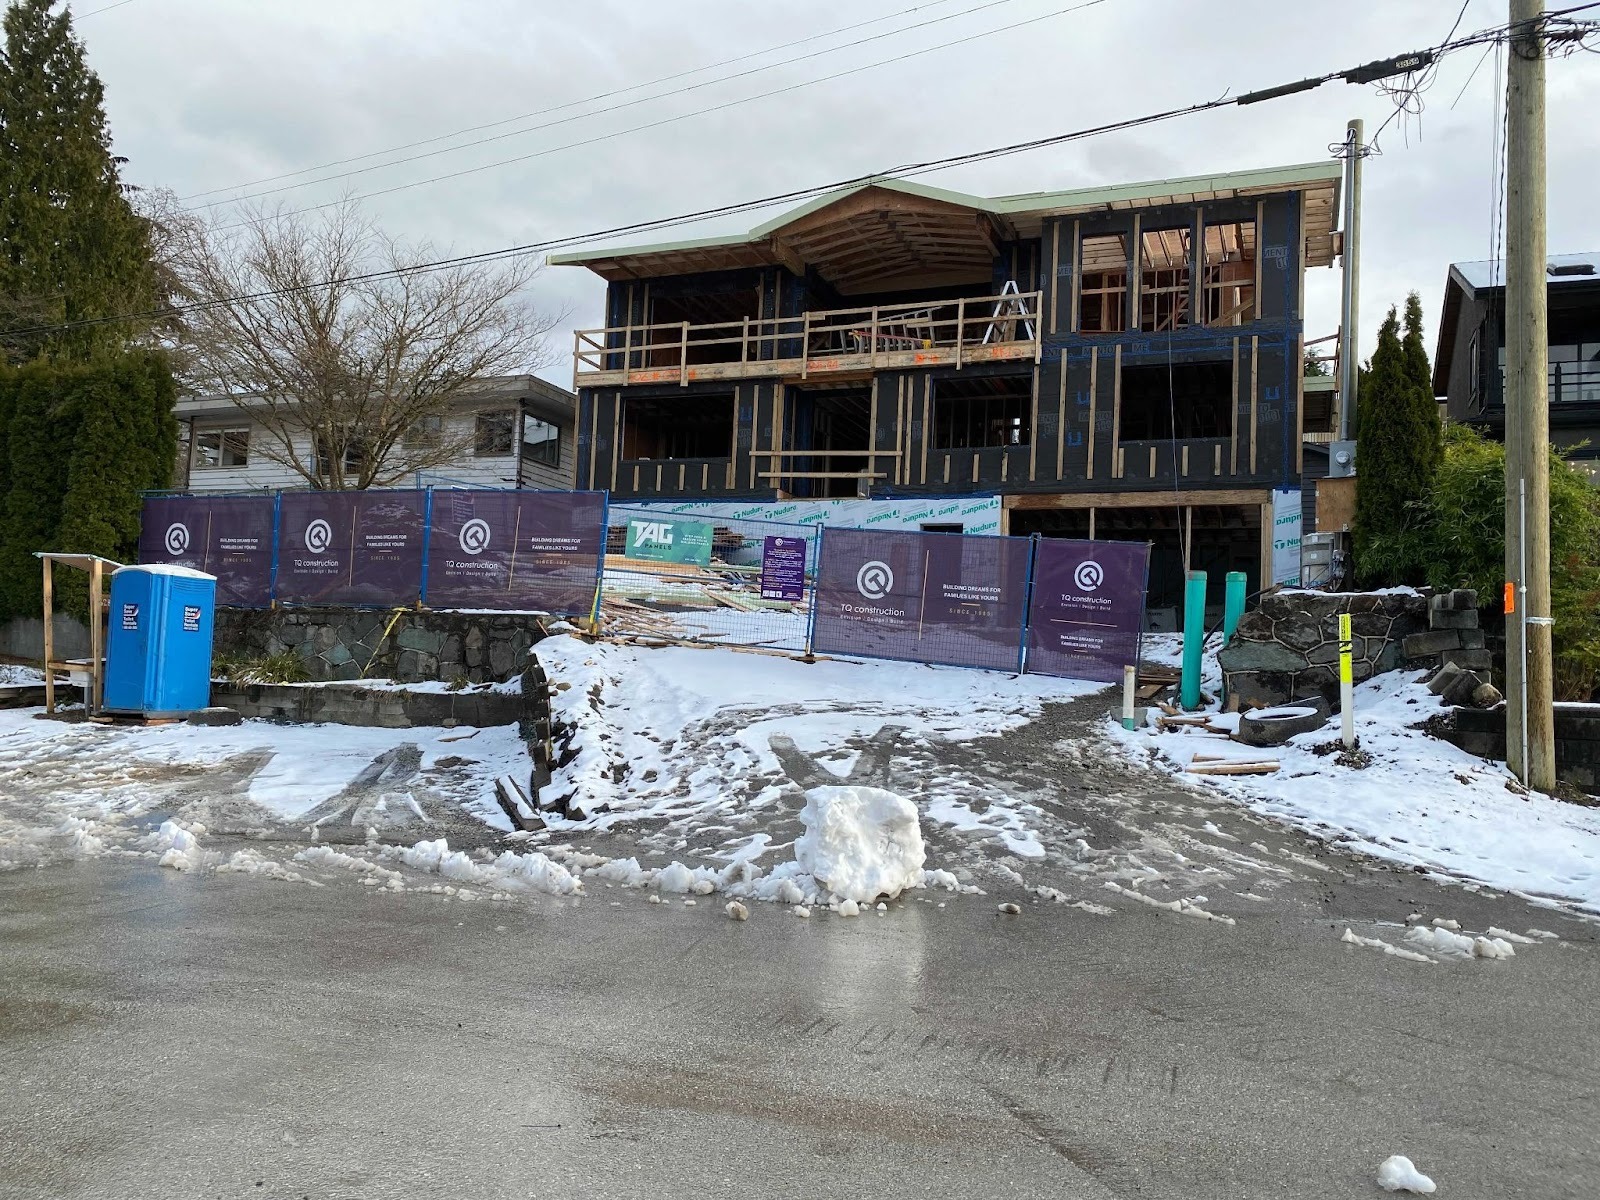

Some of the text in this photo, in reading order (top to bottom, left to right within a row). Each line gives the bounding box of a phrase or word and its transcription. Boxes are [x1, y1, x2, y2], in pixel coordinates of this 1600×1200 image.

[773, 505, 797, 517] Nudura
[961, 502, 989, 516] Nudura
[798, 512, 823, 524] Nudura
[866, 512, 892, 524] Nudura
[902, 511, 929, 523] Nudura
[970, 521, 998, 534] Nudura
[630, 520, 674, 548] TAG
[293, 559, 339, 567] TQ construction
[445, 560, 498, 569] TQ construction
[942, 583, 967, 591] BUILDING
[1072, 596, 1112, 604] construction
[840, 603, 905, 616] TQ construction
[948, 607, 970, 615] SINCE
